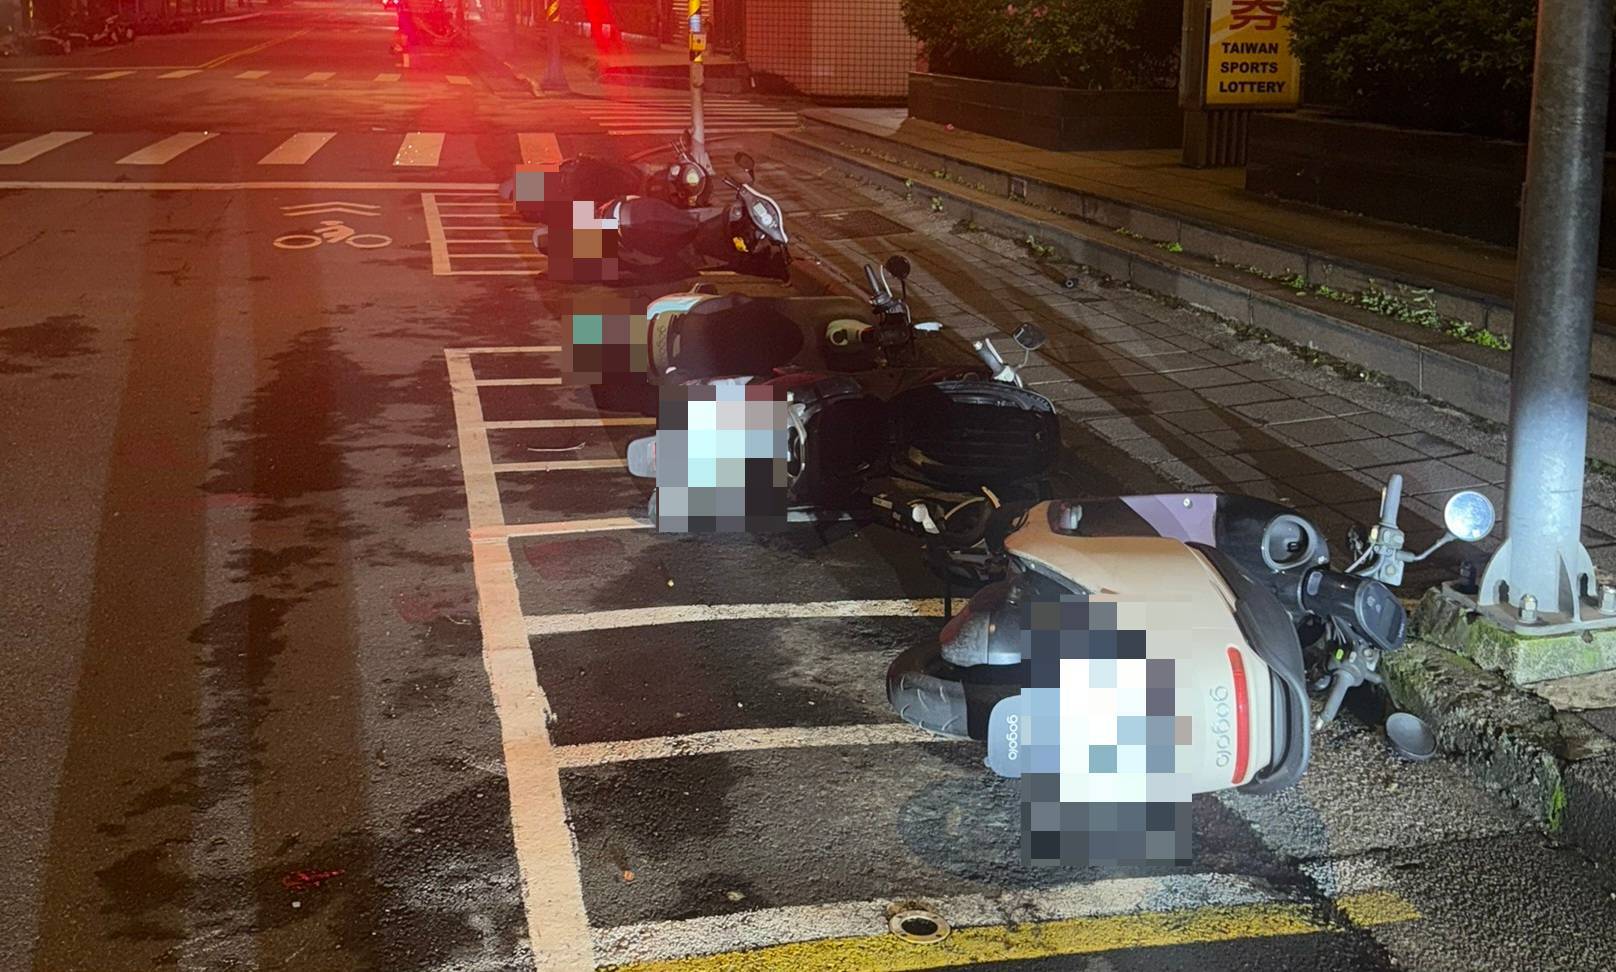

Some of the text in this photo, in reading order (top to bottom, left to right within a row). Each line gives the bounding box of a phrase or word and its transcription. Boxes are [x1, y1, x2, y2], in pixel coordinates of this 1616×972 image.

[1222, 43, 1278, 54] TAIWAN
[1220, 62, 1278, 74] SPORTS
[1219, 82, 1286, 93] LOTTERY
[1209, 685, 1232, 768] gogoro
[1006, 714, 1019, 761] gogoro
